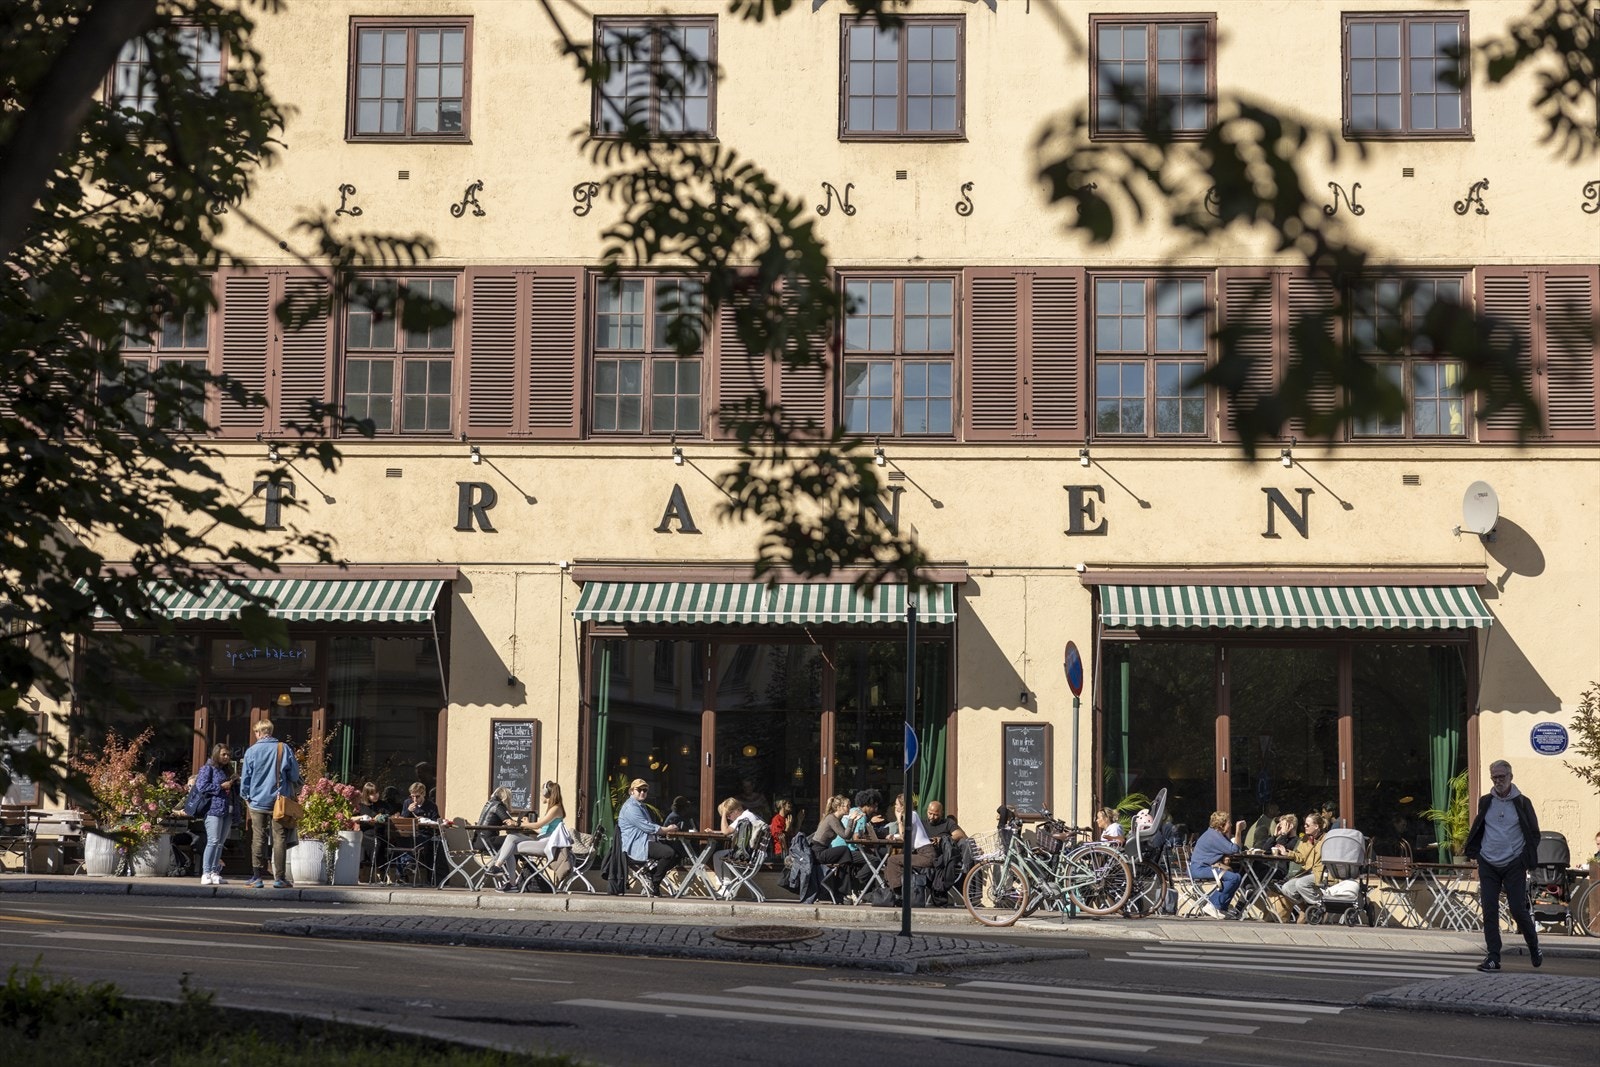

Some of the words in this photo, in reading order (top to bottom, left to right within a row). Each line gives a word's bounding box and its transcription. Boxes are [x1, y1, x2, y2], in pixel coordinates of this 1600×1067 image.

[572, 178, 1600, 217] PNSNAT
[251, 479, 1316, 539] TRANEN
[265, 647, 307, 660] bakeri
